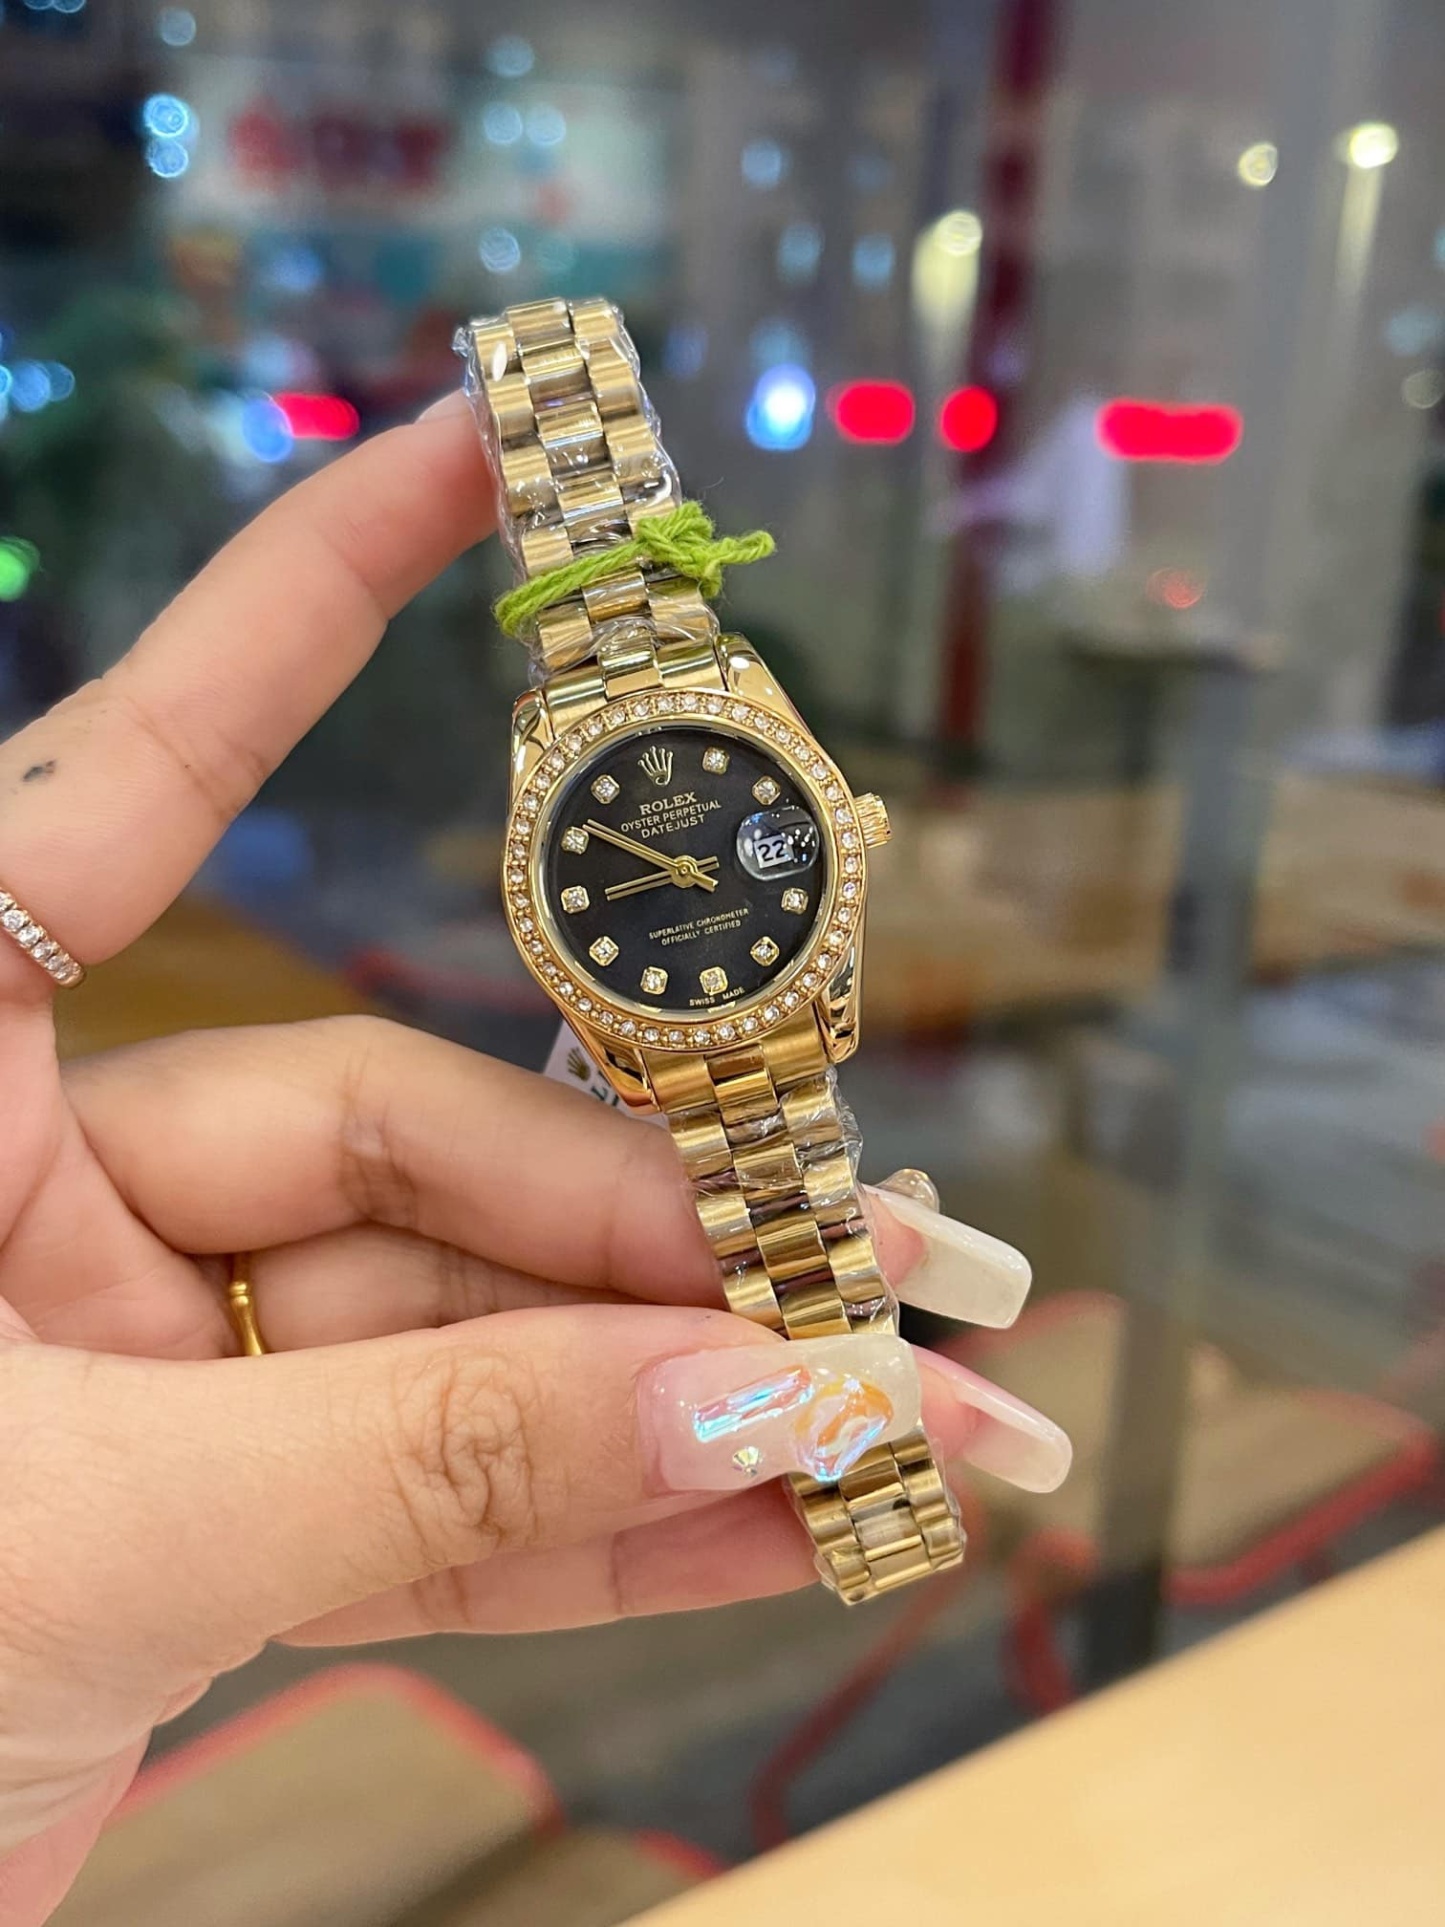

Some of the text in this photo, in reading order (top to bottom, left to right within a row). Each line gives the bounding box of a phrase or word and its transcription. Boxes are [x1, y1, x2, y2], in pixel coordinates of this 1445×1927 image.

[639, 791, 697, 816] ROLEX
[621, 800, 722, 833] OYSTER PERPETUAL
[641, 814, 706, 839] DATEJUST
[758, 840, 786, 862] 22
[649, 908, 749, 940] SUPERLATIVE CHRONOMETER
[661, 920, 741, 946] OFFICIALLY CERTIFIED
[689, 987, 746, 1007] SWISS MADE
